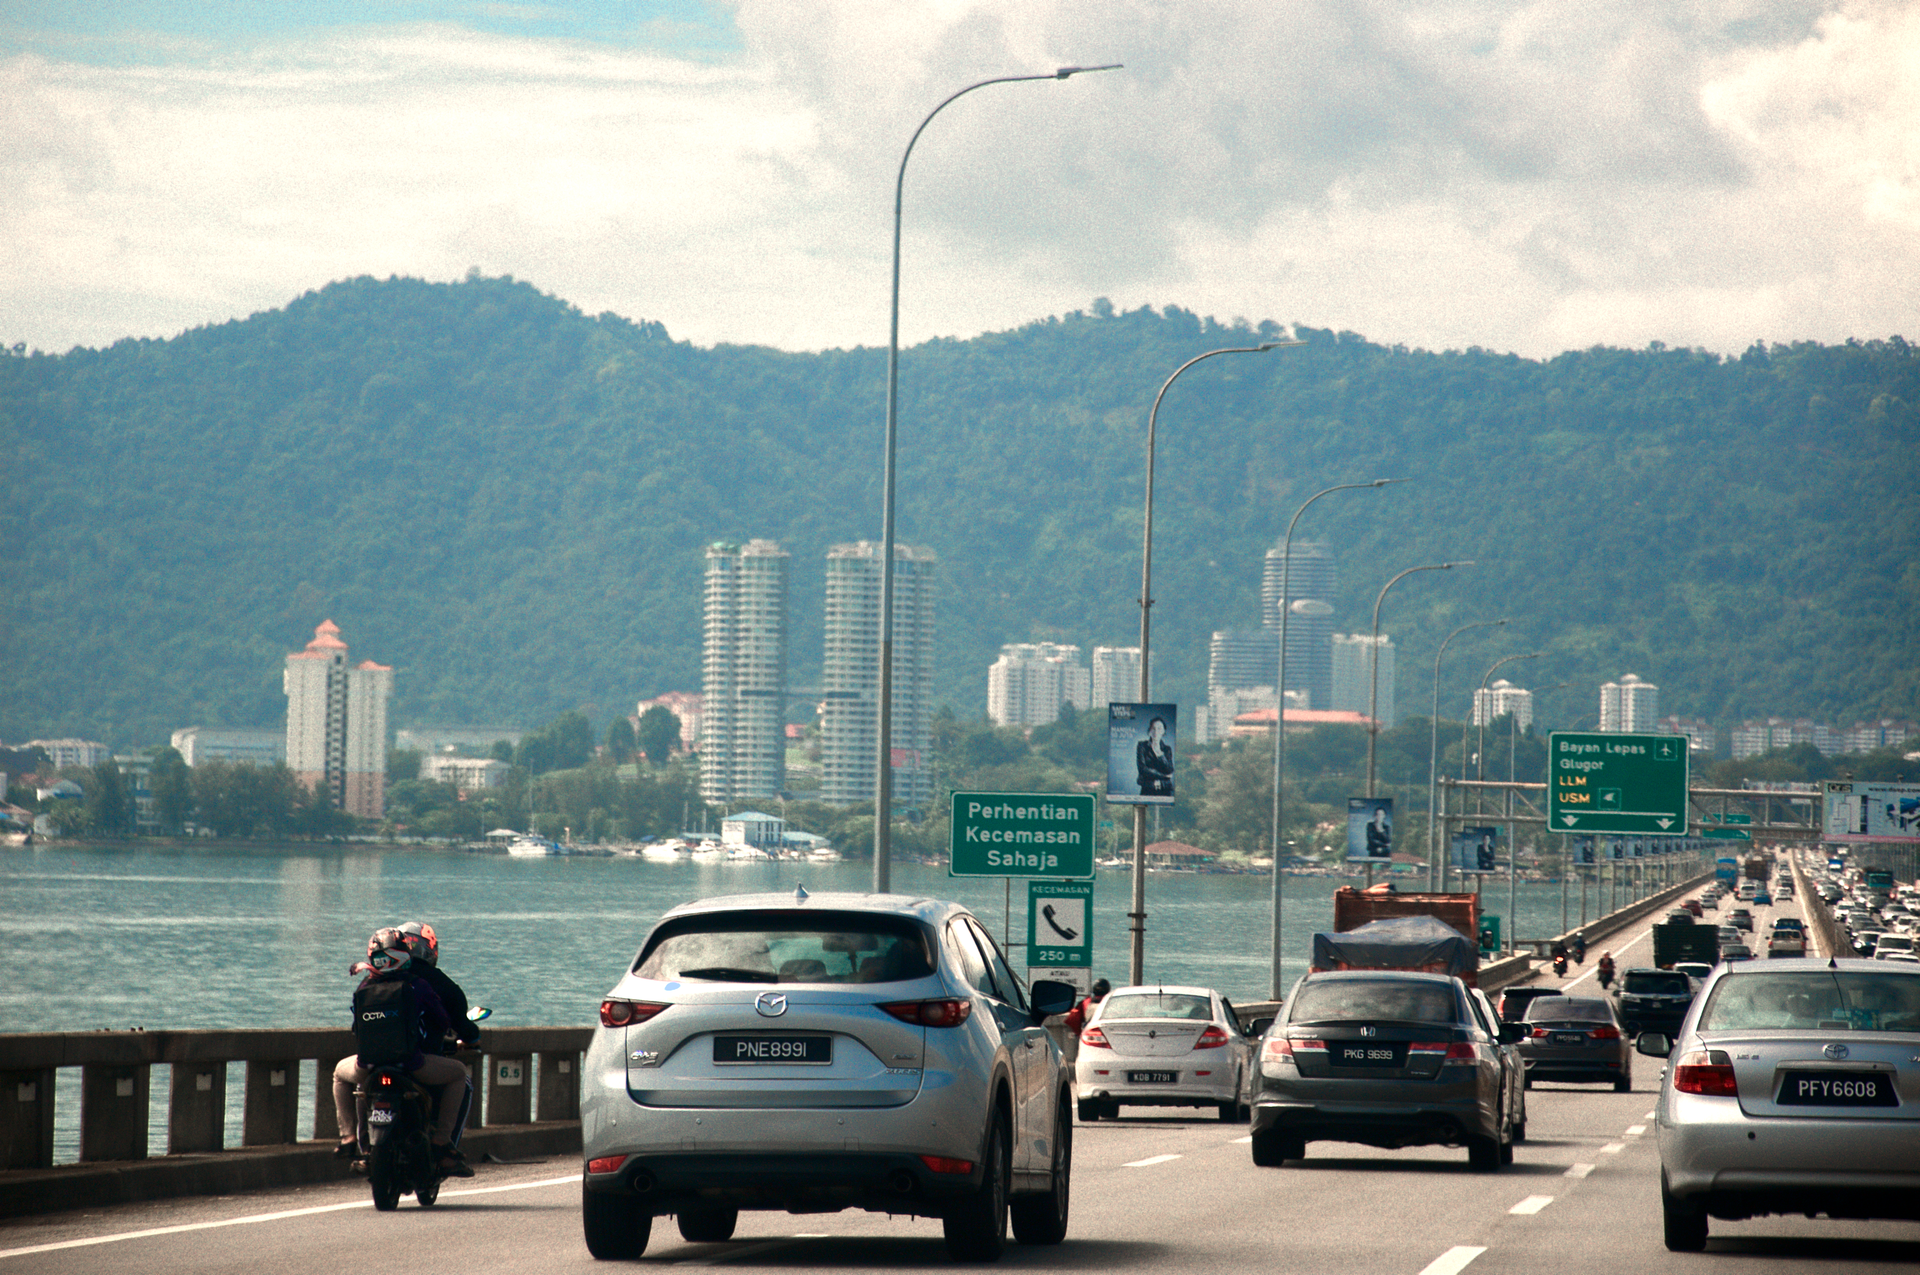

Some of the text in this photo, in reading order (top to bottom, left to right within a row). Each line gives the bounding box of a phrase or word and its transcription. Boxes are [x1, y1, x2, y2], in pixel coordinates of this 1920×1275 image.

[1560, 741, 1646, 756] Bayan Lepas
[1560, 759, 1605, 772] Glugor
[1559, 776, 1587, 786] LLM
[1559, 792, 1590, 803] USM
[968, 802, 1079, 820] Perhentian
[966, 825, 1081, 844] Kecemasan
[987, 850, 1059, 872] Sahaja
[1032, 885, 1090, 894] KECEMASAN
[1039, 950, 1081, 961] 250 m
[737, 1042, 807, 1057] PNE8991
[1343, 1049, 1393, 1060] PKG 9699
[500, 1066, 520, 1079] 6.5
[1134, 1073, 1170, 1081] KDB 7791
[1798, 1080, 1877, 1097] PFY6608
